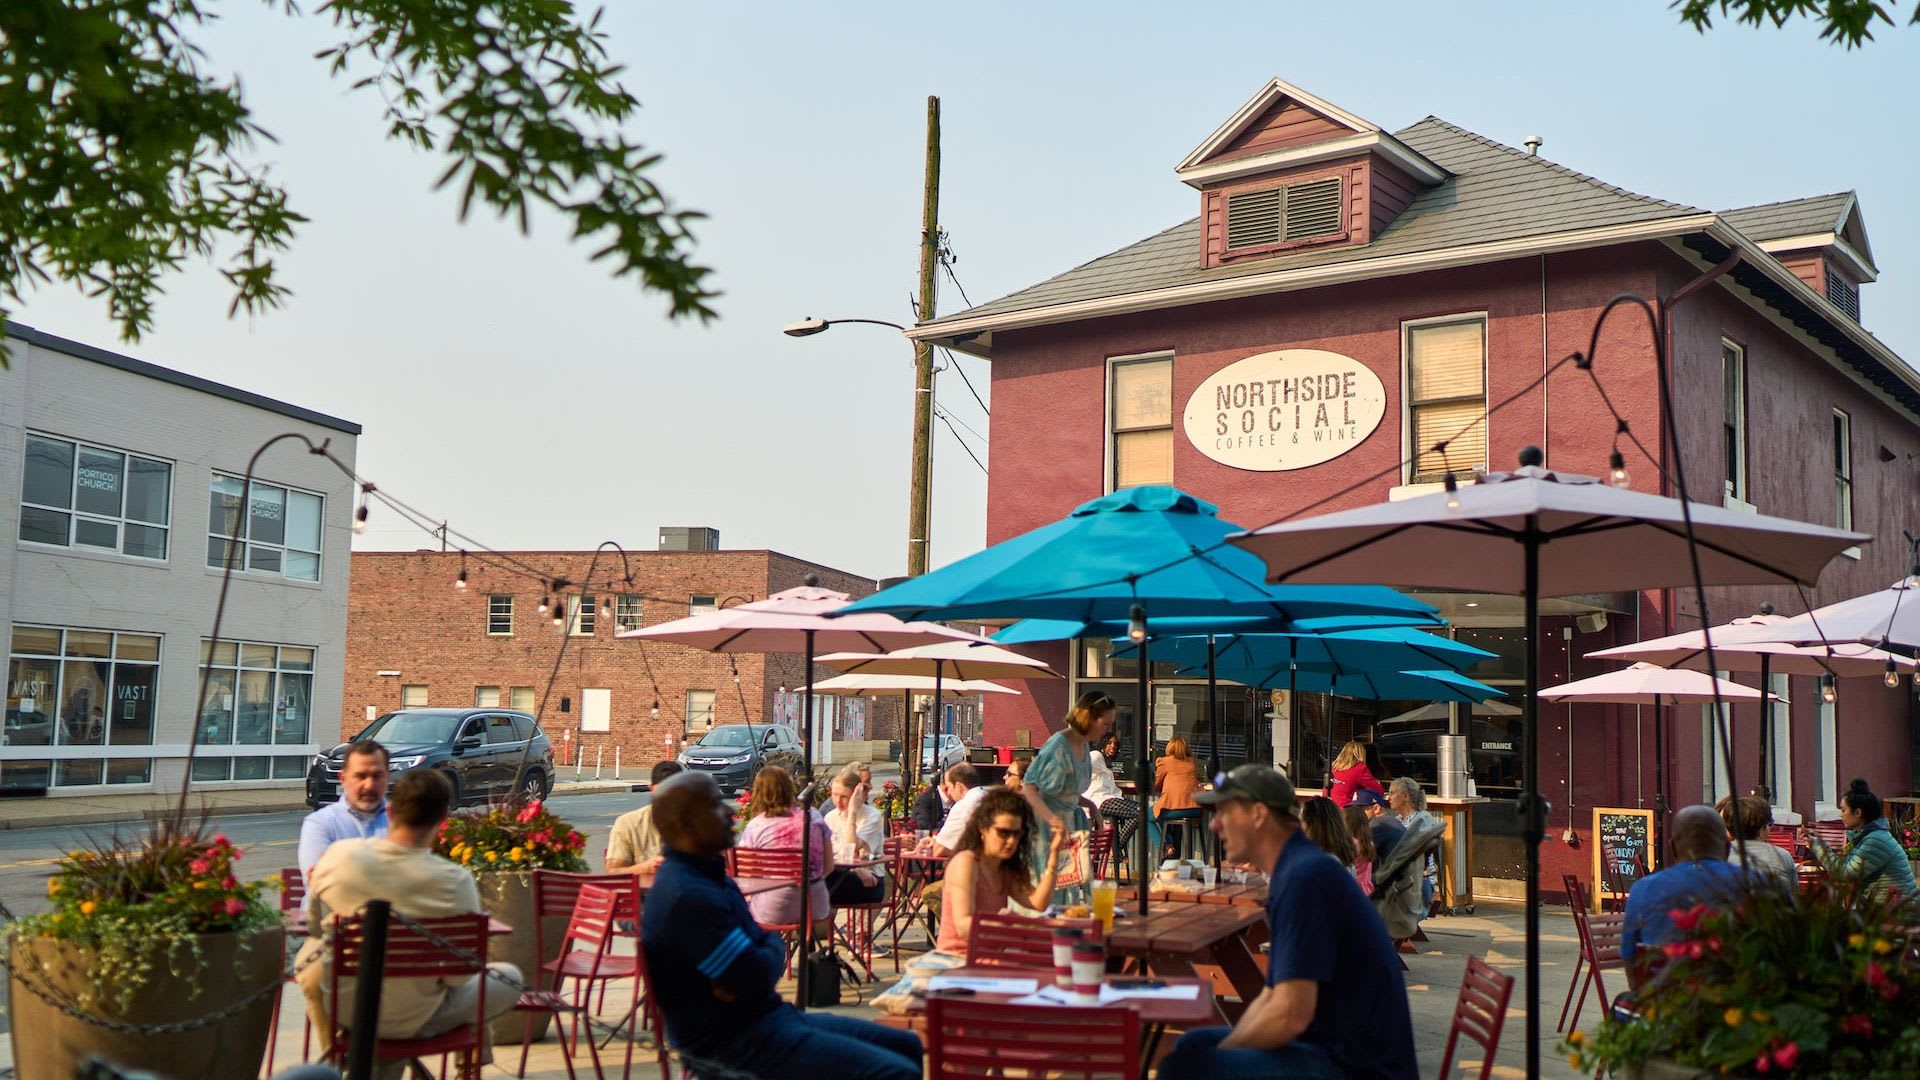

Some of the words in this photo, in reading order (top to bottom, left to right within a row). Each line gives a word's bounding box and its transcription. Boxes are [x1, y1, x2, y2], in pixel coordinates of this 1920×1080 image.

[1216, 372, 1356, 411] NORTHSIDE
[1216, 400, 1356, 436] SOCIAL
[1216, 433, 1275, 450] COFFEE
[1292, 432, 1299, 444] &
[1314, 427, 1356, 442] WINE
[79, 467, 113, 481] PORTICO
[79, 477, 113, 491] CHURCH
[13, 681, 46, 696] VAST
[118, 685, 148, 700] VAST
[1481, 742, 1513, 750] ENTRANCE
[1610, 863, 1635, 875] IDAY
